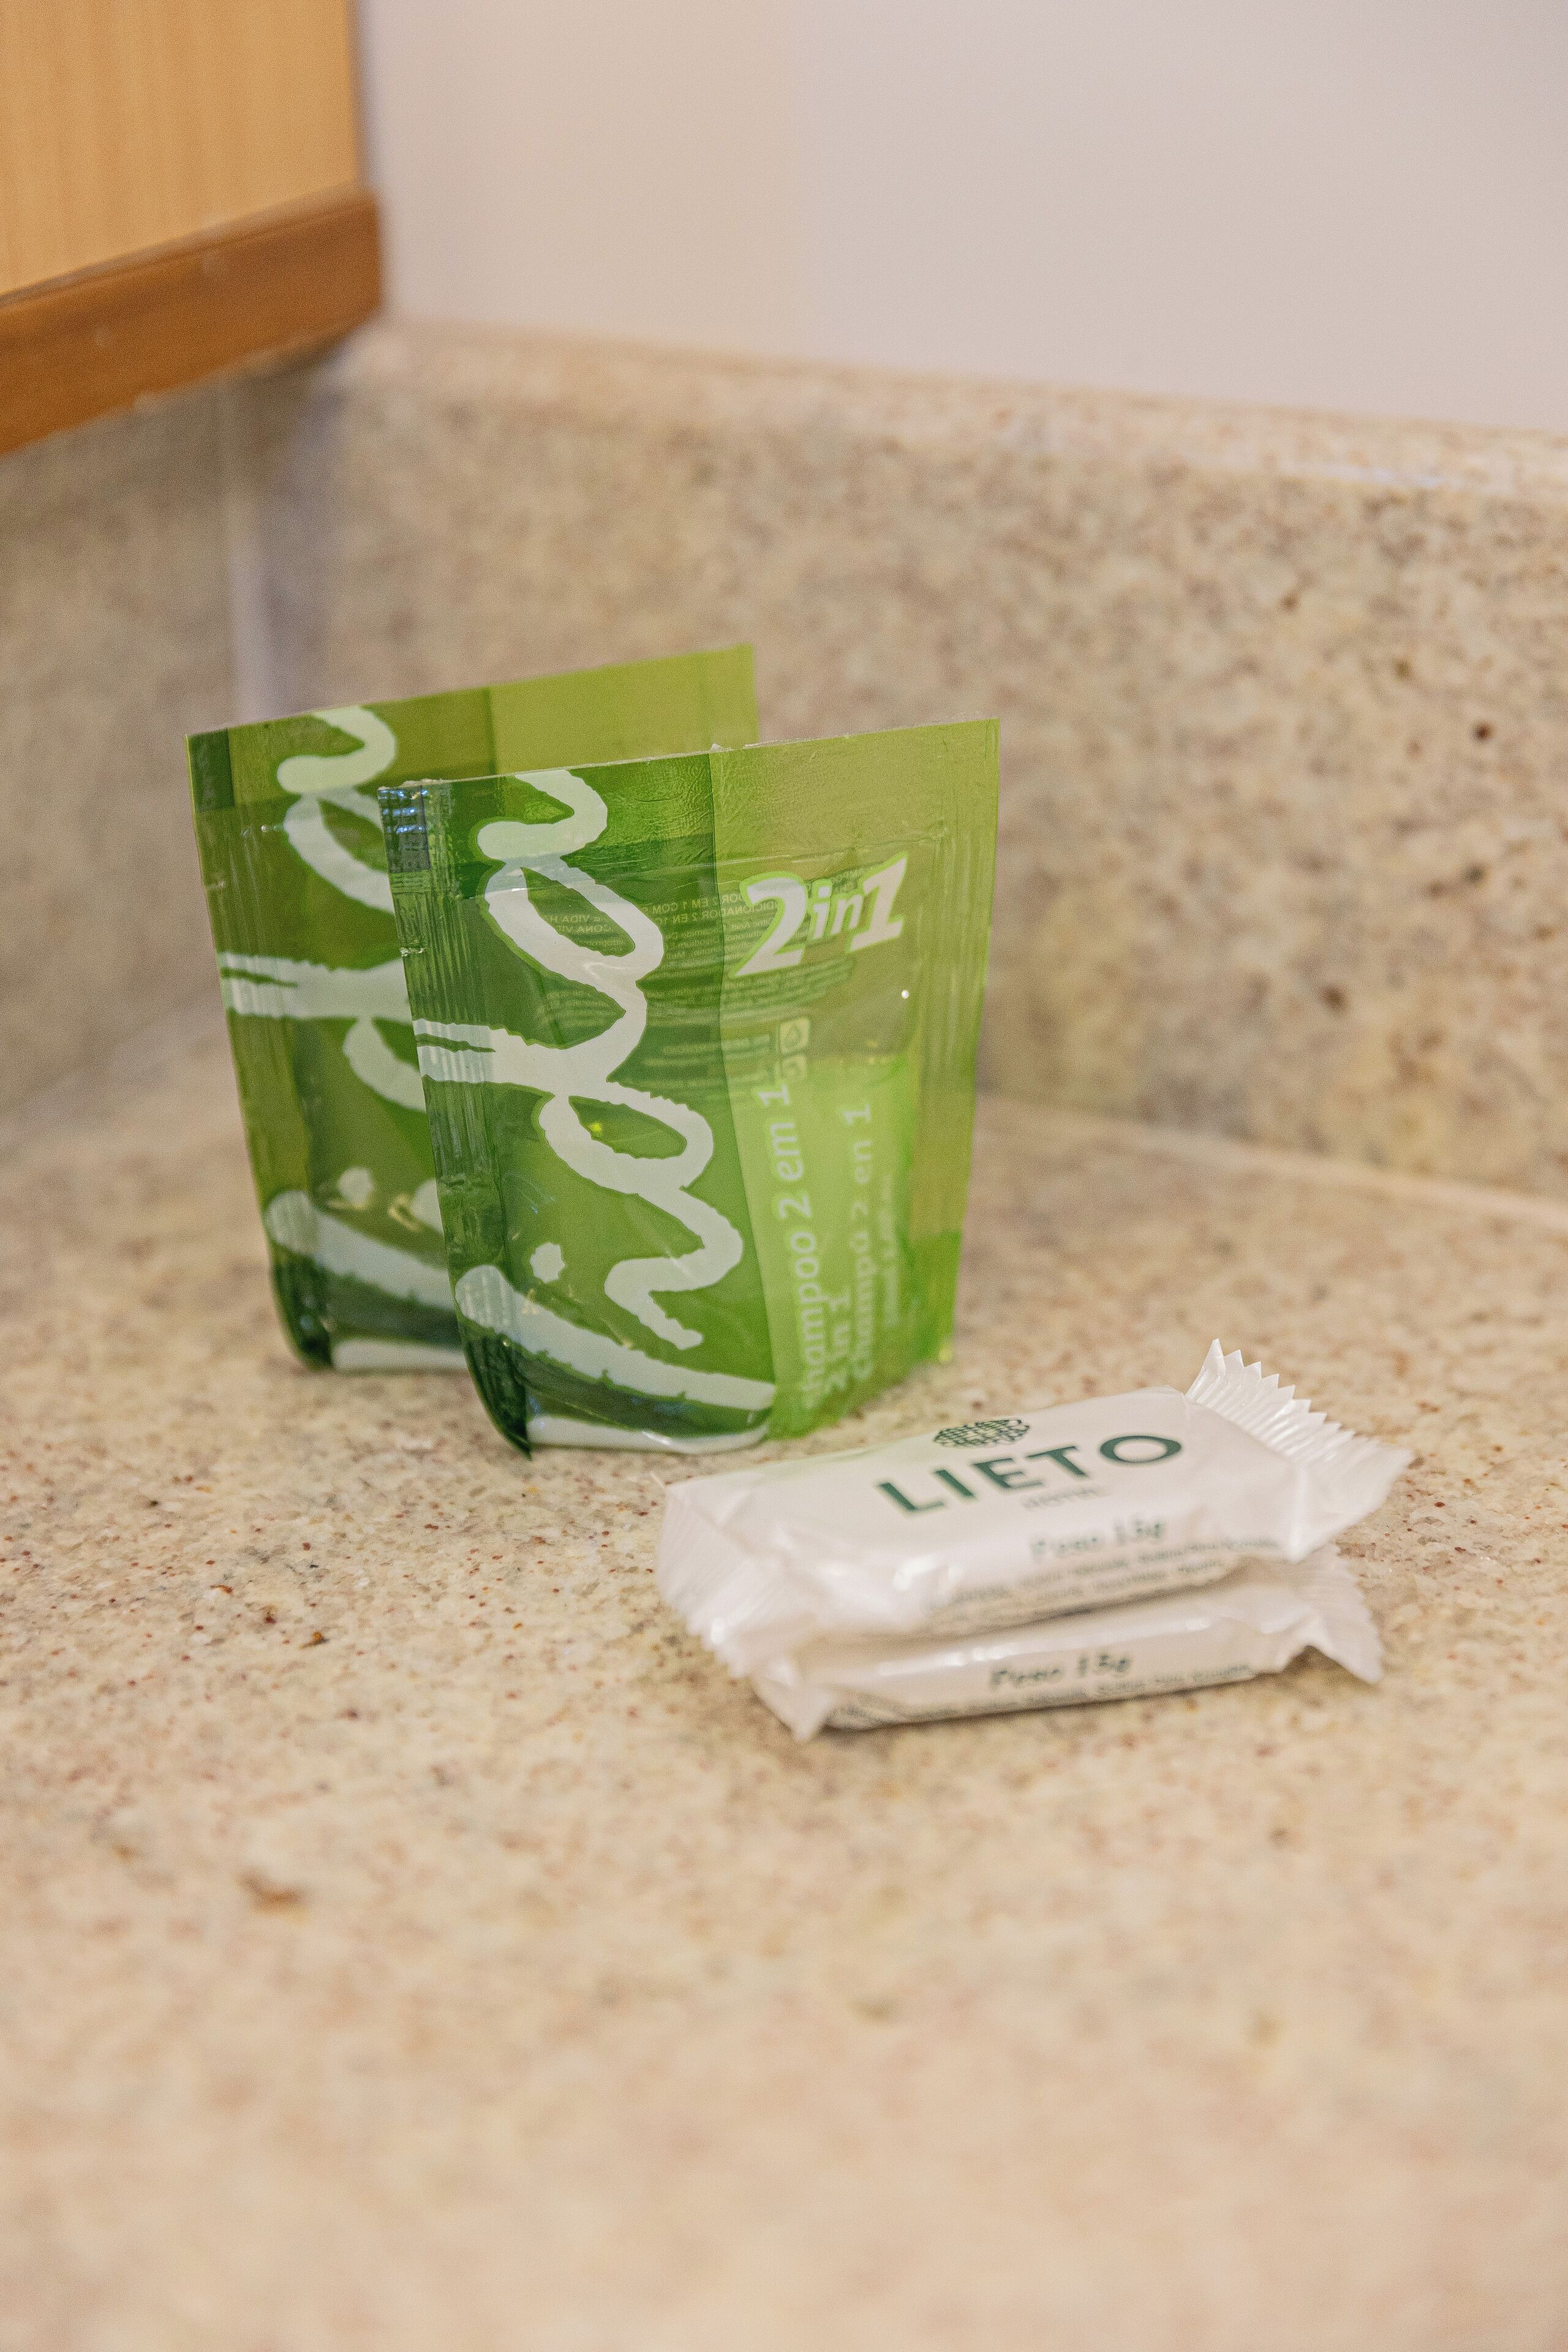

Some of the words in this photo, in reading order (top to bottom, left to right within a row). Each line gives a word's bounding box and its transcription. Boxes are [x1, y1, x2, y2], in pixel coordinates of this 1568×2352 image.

[733, 854, 908, 978] 2in1
[758, 1084, 790, 1107] 1
[842, 1104, 871, 1125] 1
[767, 1120, 804, 1182] em
[777, 1195, 811, 1219] 2
[877, 1435, 1183, 1514] LIETO
